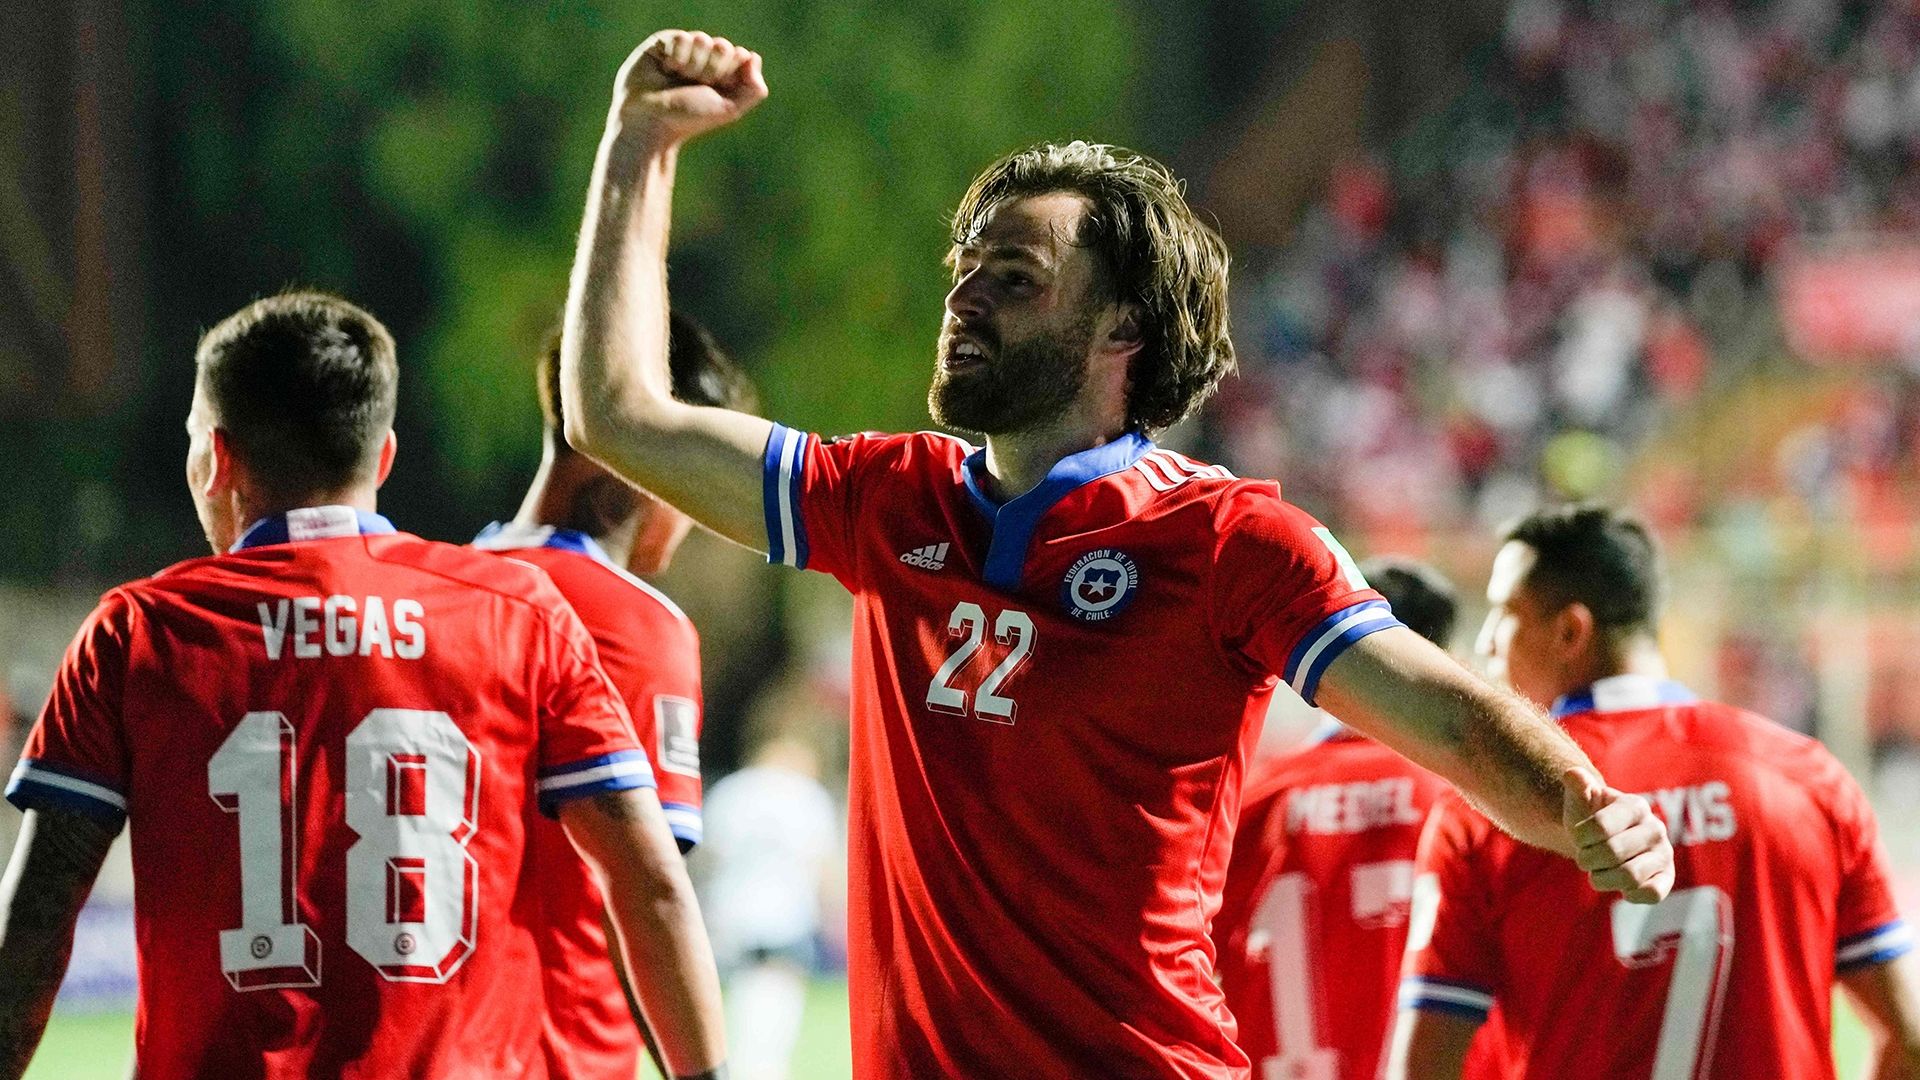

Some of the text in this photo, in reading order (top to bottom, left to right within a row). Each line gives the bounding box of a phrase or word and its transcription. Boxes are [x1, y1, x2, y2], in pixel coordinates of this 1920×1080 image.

[900, 553, 945, 570] adidas
[1063, 549, 1138, 590] FEDERACION DE FUTBOL
[257, 595, 426, 660] VEGAS
[1071, 607, 1110, 620] DE CHILE
[926, 601, 1038, 726] 22
[208, 708, 482, 992] 18
[1610, 885, 1735, 1080] 7
